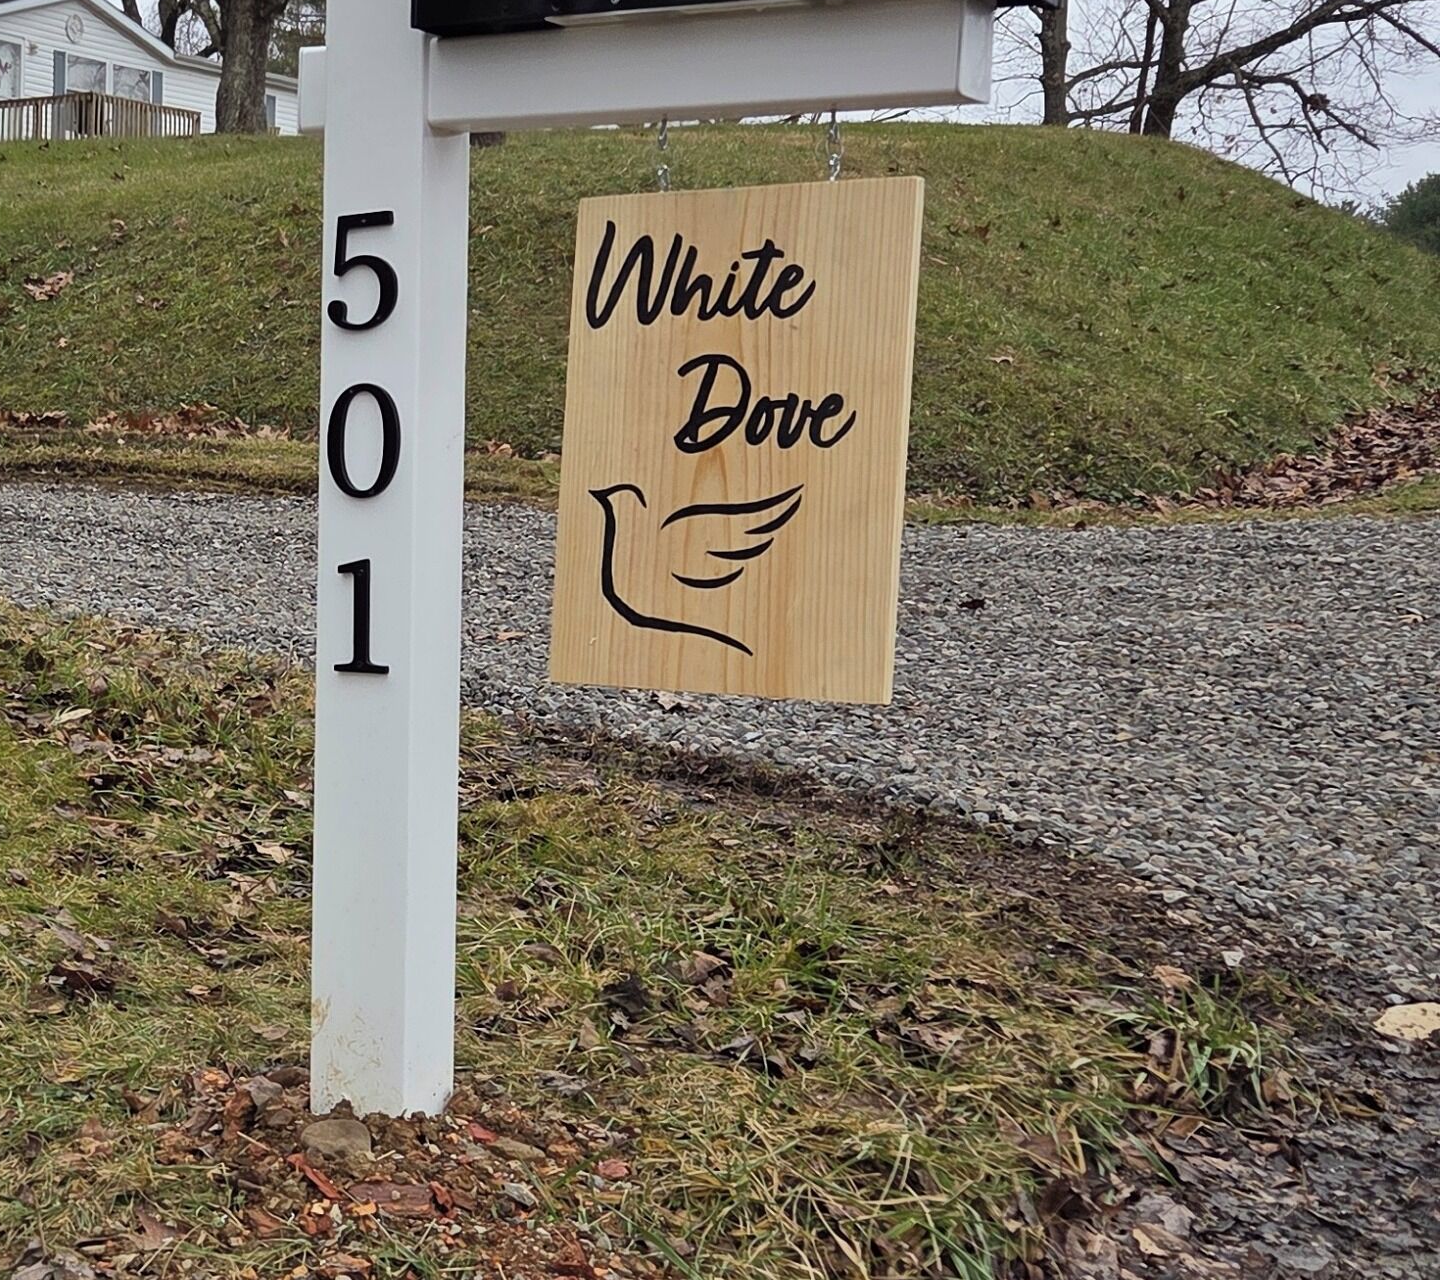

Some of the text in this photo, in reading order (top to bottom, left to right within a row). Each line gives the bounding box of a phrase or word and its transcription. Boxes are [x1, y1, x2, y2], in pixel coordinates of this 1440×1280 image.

[585, 220, 817, 330] White
[327, 210, 401, 674] 501
[673, 353, 857, 454] Dove
